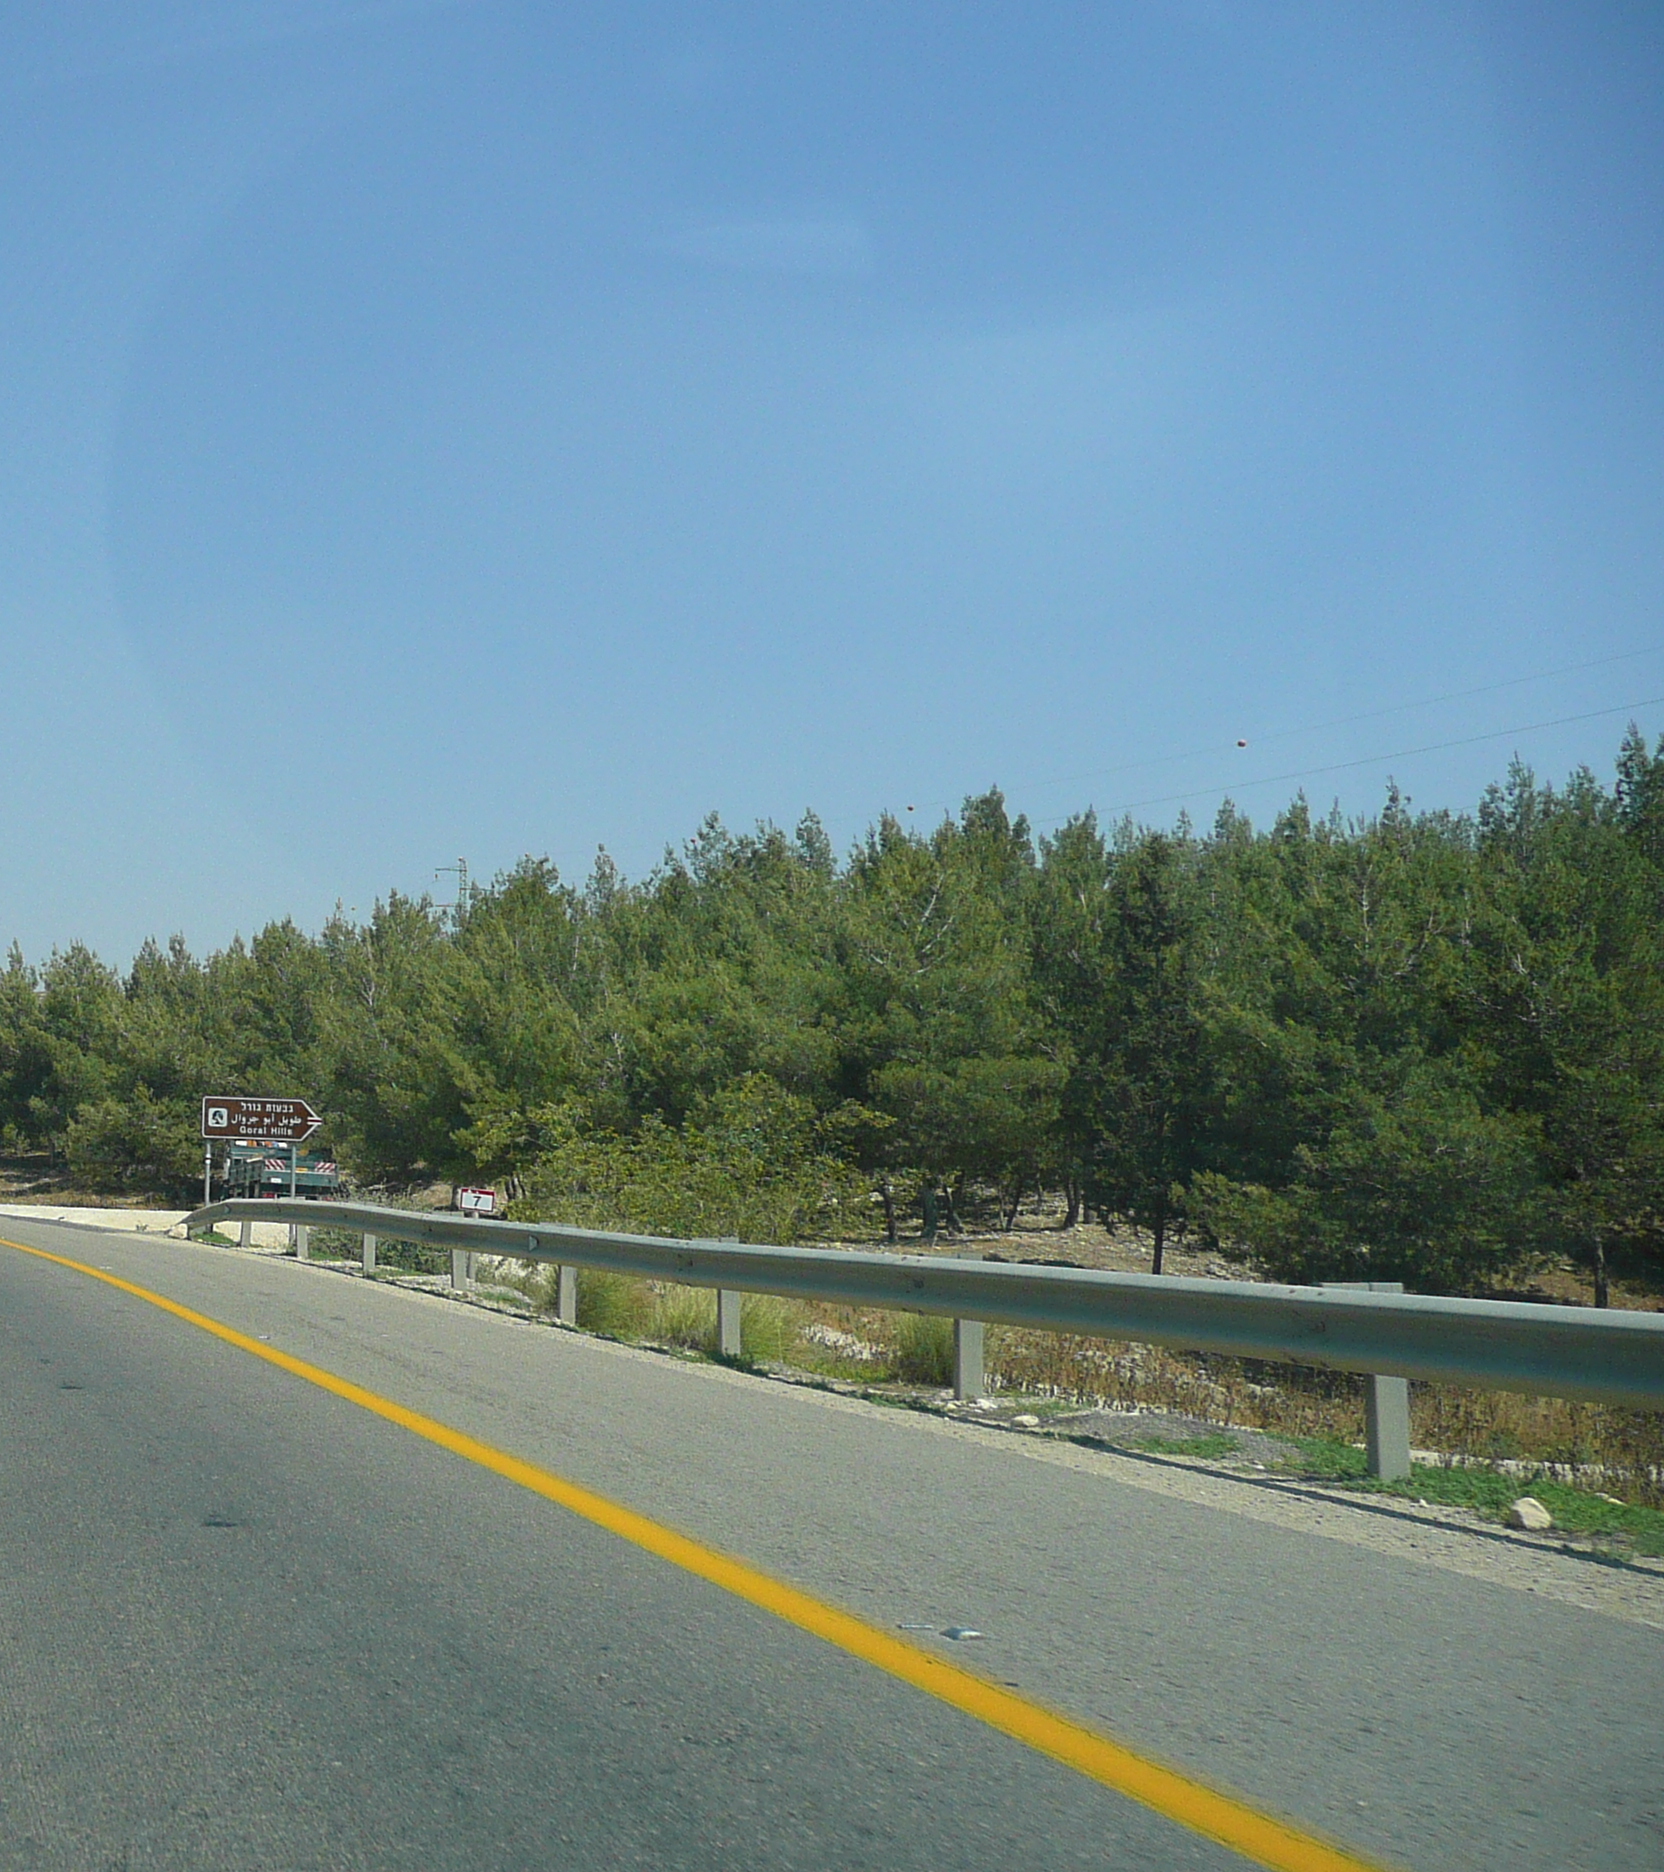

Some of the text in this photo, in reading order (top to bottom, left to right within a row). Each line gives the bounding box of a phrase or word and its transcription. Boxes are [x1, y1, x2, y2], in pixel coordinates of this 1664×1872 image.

[241, 1102, 294, 1113] גבעות גורל
[278, 1115, 302, 1126] طويل
[239, 1126, 293, 1136] Goral Hills
[473, 1196, 482, 1207] 7
